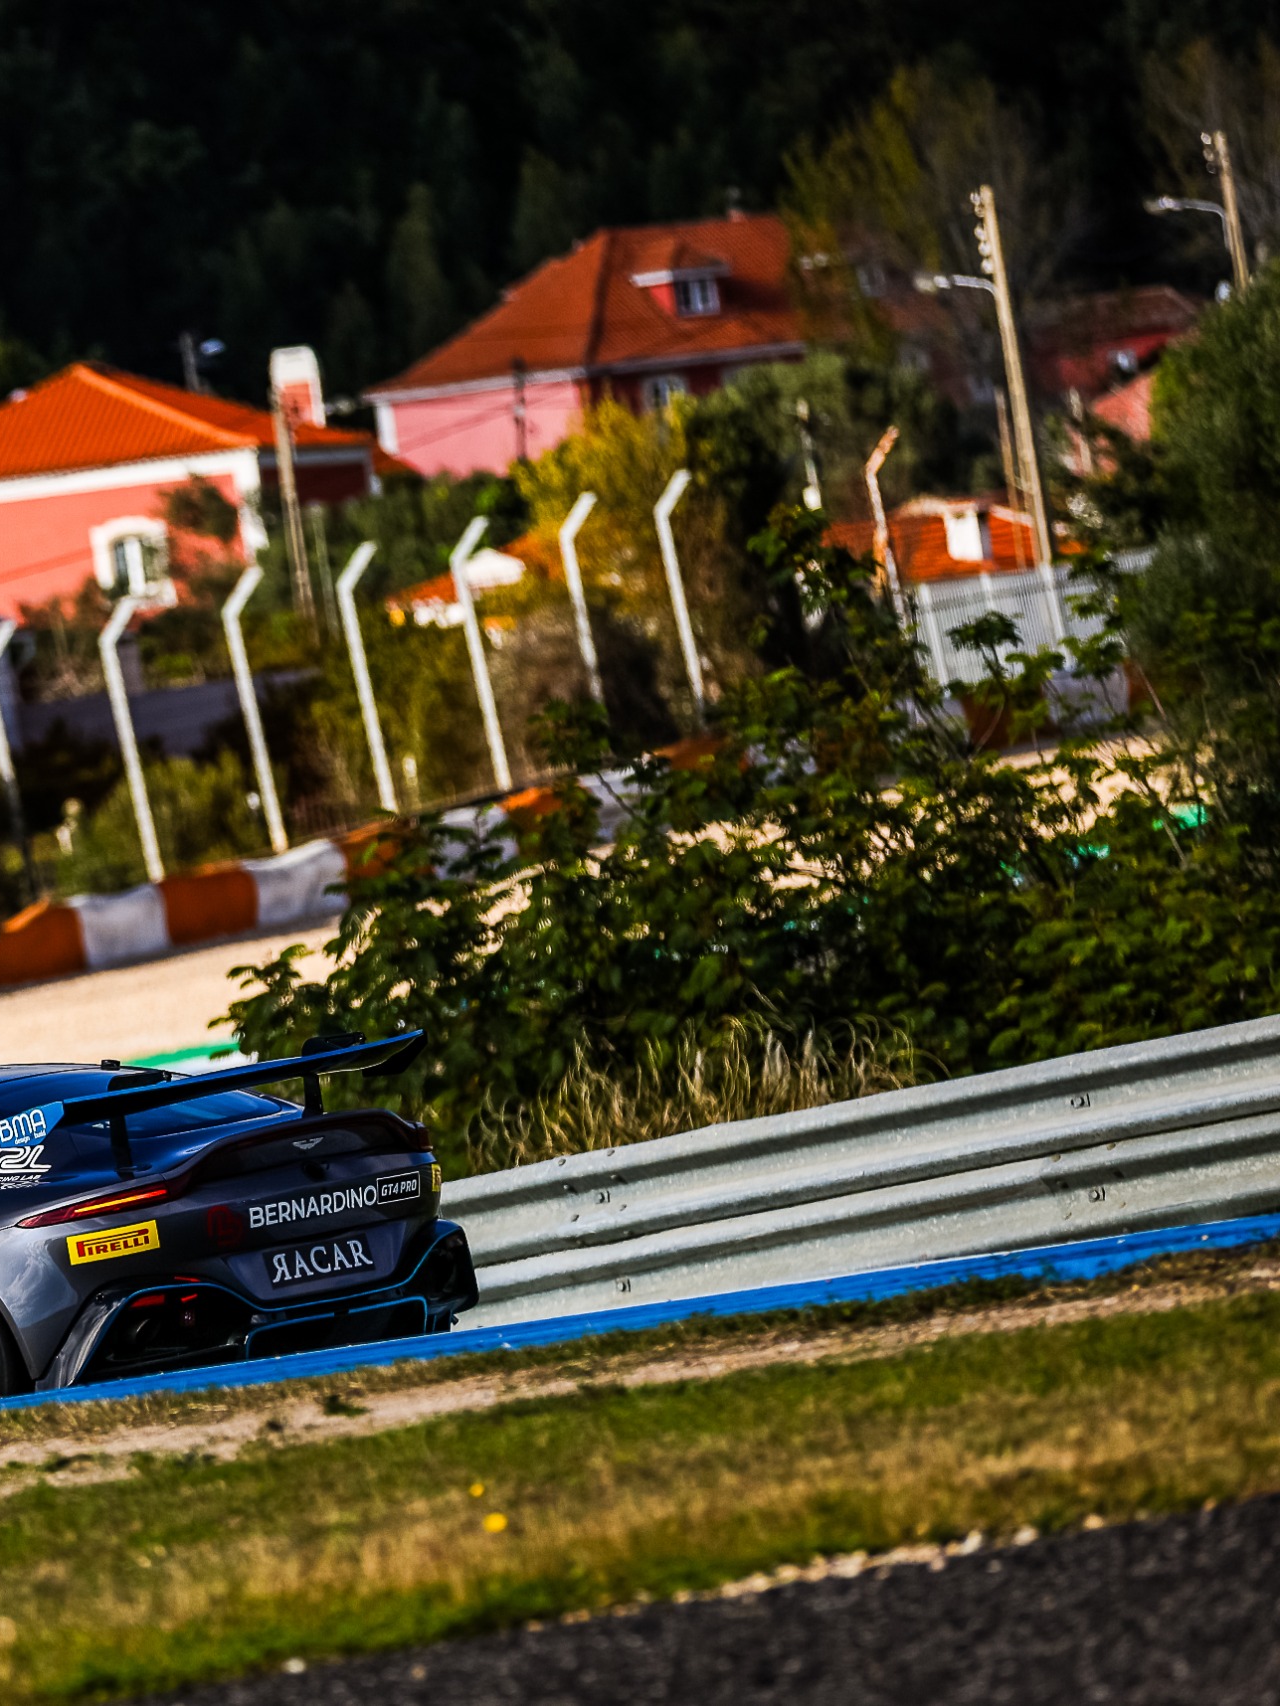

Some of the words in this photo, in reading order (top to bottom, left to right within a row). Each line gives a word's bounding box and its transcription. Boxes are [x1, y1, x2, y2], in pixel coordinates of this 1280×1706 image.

[20, 1174, 42, 1182] LAB
[249, 1185, 377, 1229] BERNARDINO
[381, 1182, 399, 1197] GT4
[400, 1179, 417, 1194] PRO
[76, 1228, 150, 1258] PIRELLI
